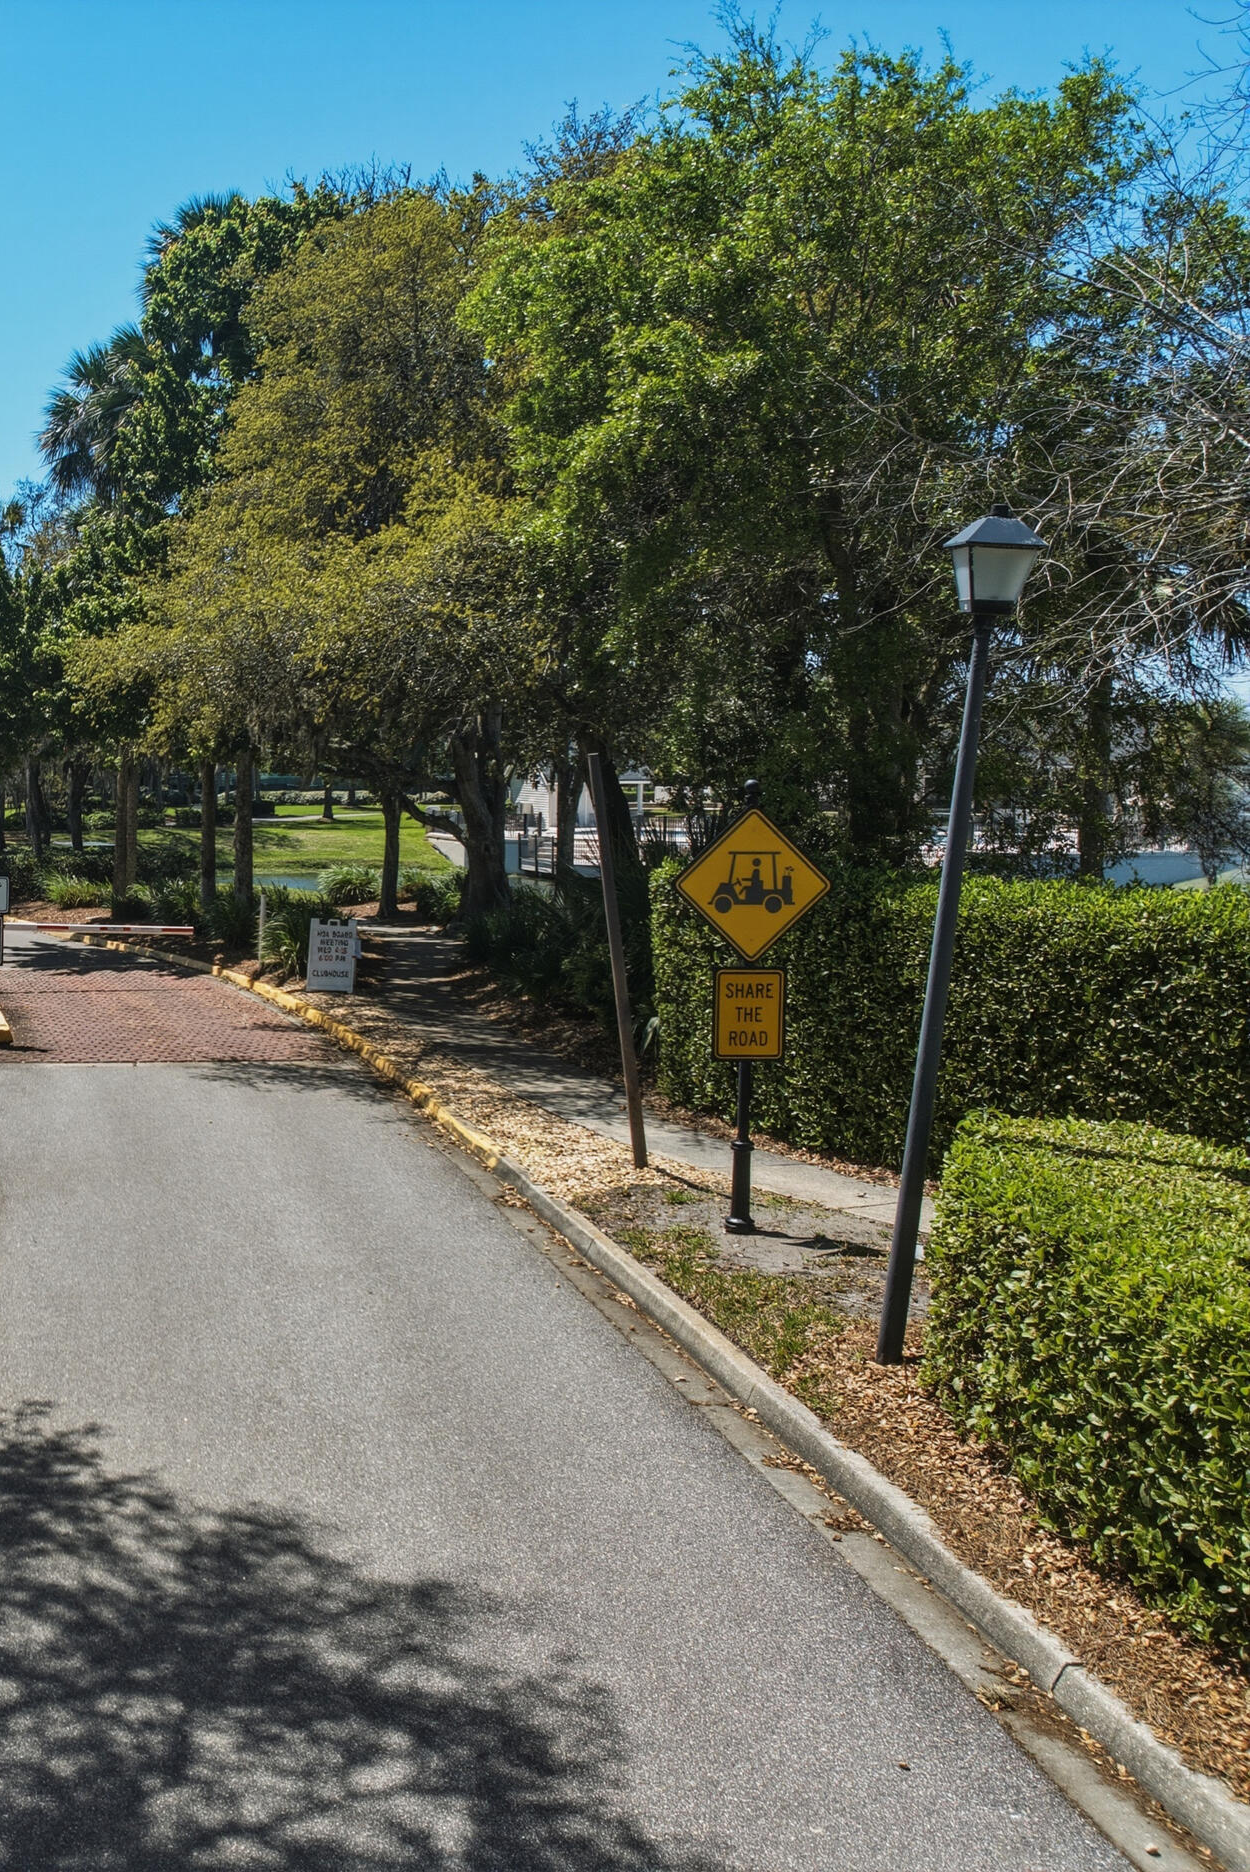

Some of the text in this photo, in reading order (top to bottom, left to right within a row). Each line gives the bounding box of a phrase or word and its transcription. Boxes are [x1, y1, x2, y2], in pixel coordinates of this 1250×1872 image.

[311, 970, 350, 978] CLUBHOUSE
[725, 983, 774, 999] SHARE
[735, 1006, 763, 1023] THE
[728, 1030, 768, 1047] ROAD
